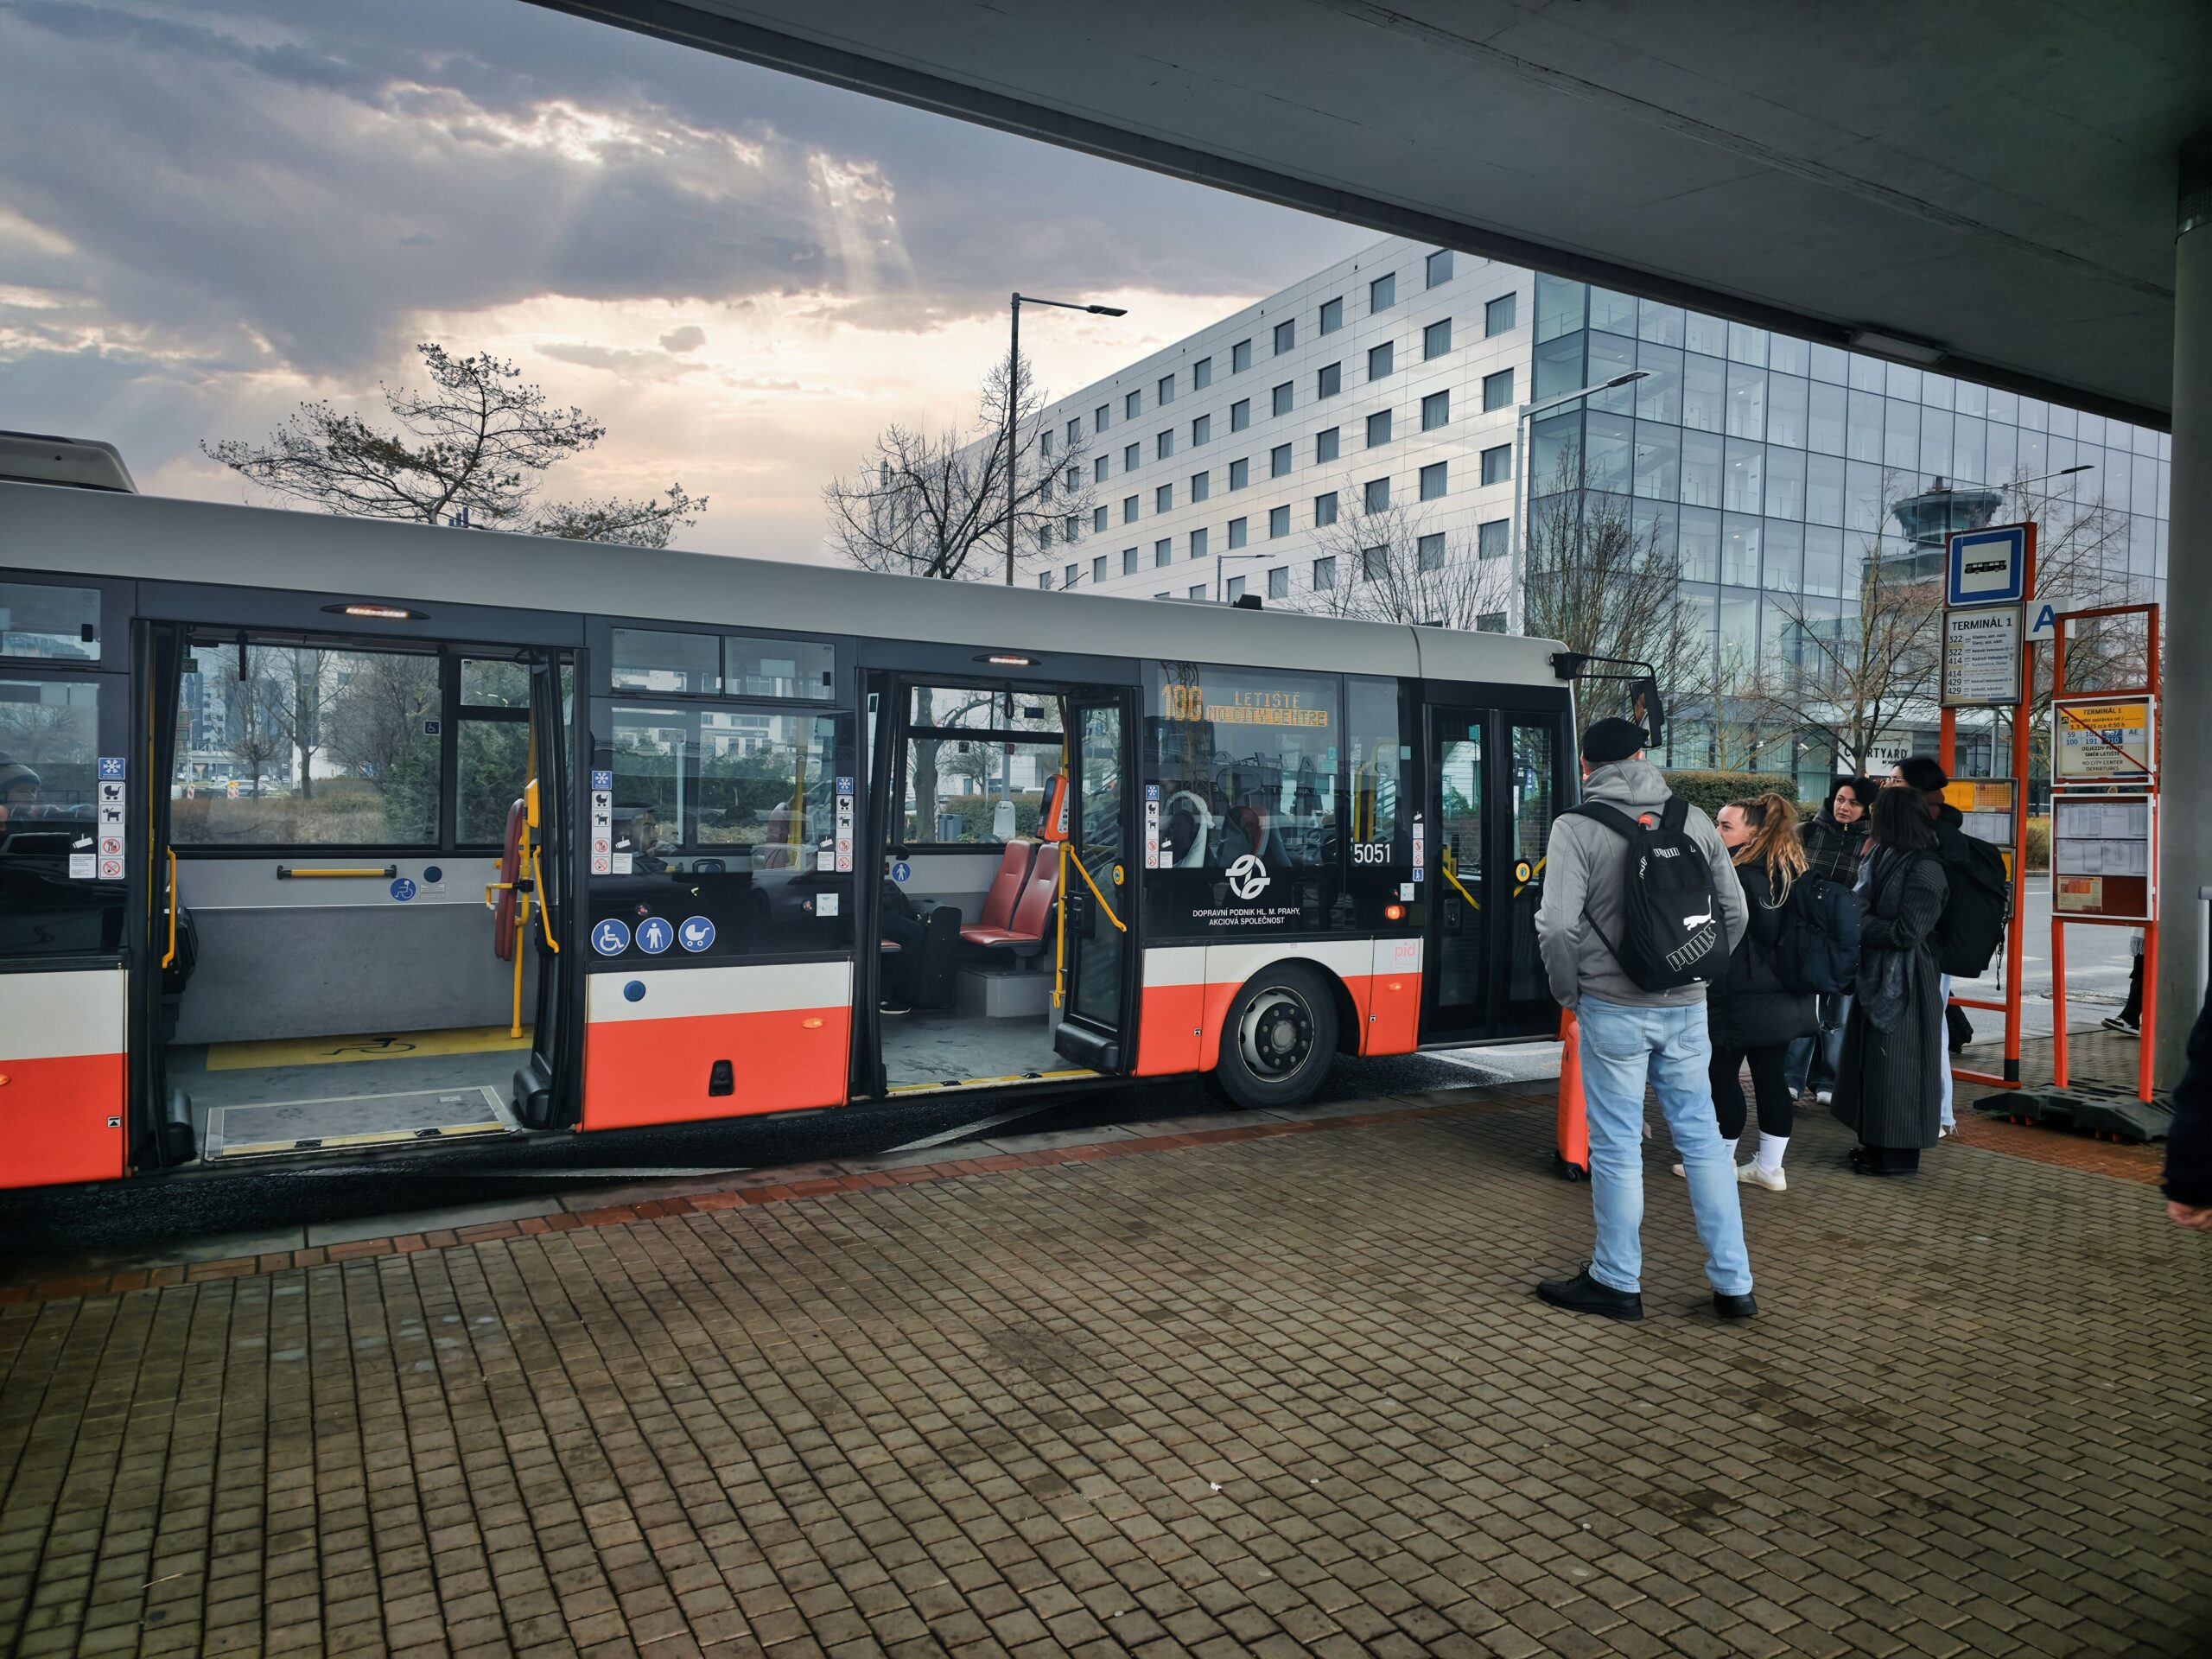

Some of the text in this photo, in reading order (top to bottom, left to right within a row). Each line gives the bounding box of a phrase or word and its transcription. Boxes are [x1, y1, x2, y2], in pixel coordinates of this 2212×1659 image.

[1952, 616, 2012, 631] TERMINÁL 1
[2032, 605, 2055, 632] A
[1949, 635, 1963, 644] 322
[1948, 648, 1963, 657] 322
[1161, 683, 1203, 722] 100
[1235, 690, 1300, 709] LETIŠTĚ
[1844, 747, 1907, 760] CRTYARD
[1354, 843, 1390, 863] 5051
[1192, 907, 1228, 917] DOPRAVNÍ
[1277, 907, 1300, 916] PRAHY,
[1209, 916, 1285, 926] AKCIOVÁ SPOLEČNOST
[1394, 942, 1416, 960] pid
